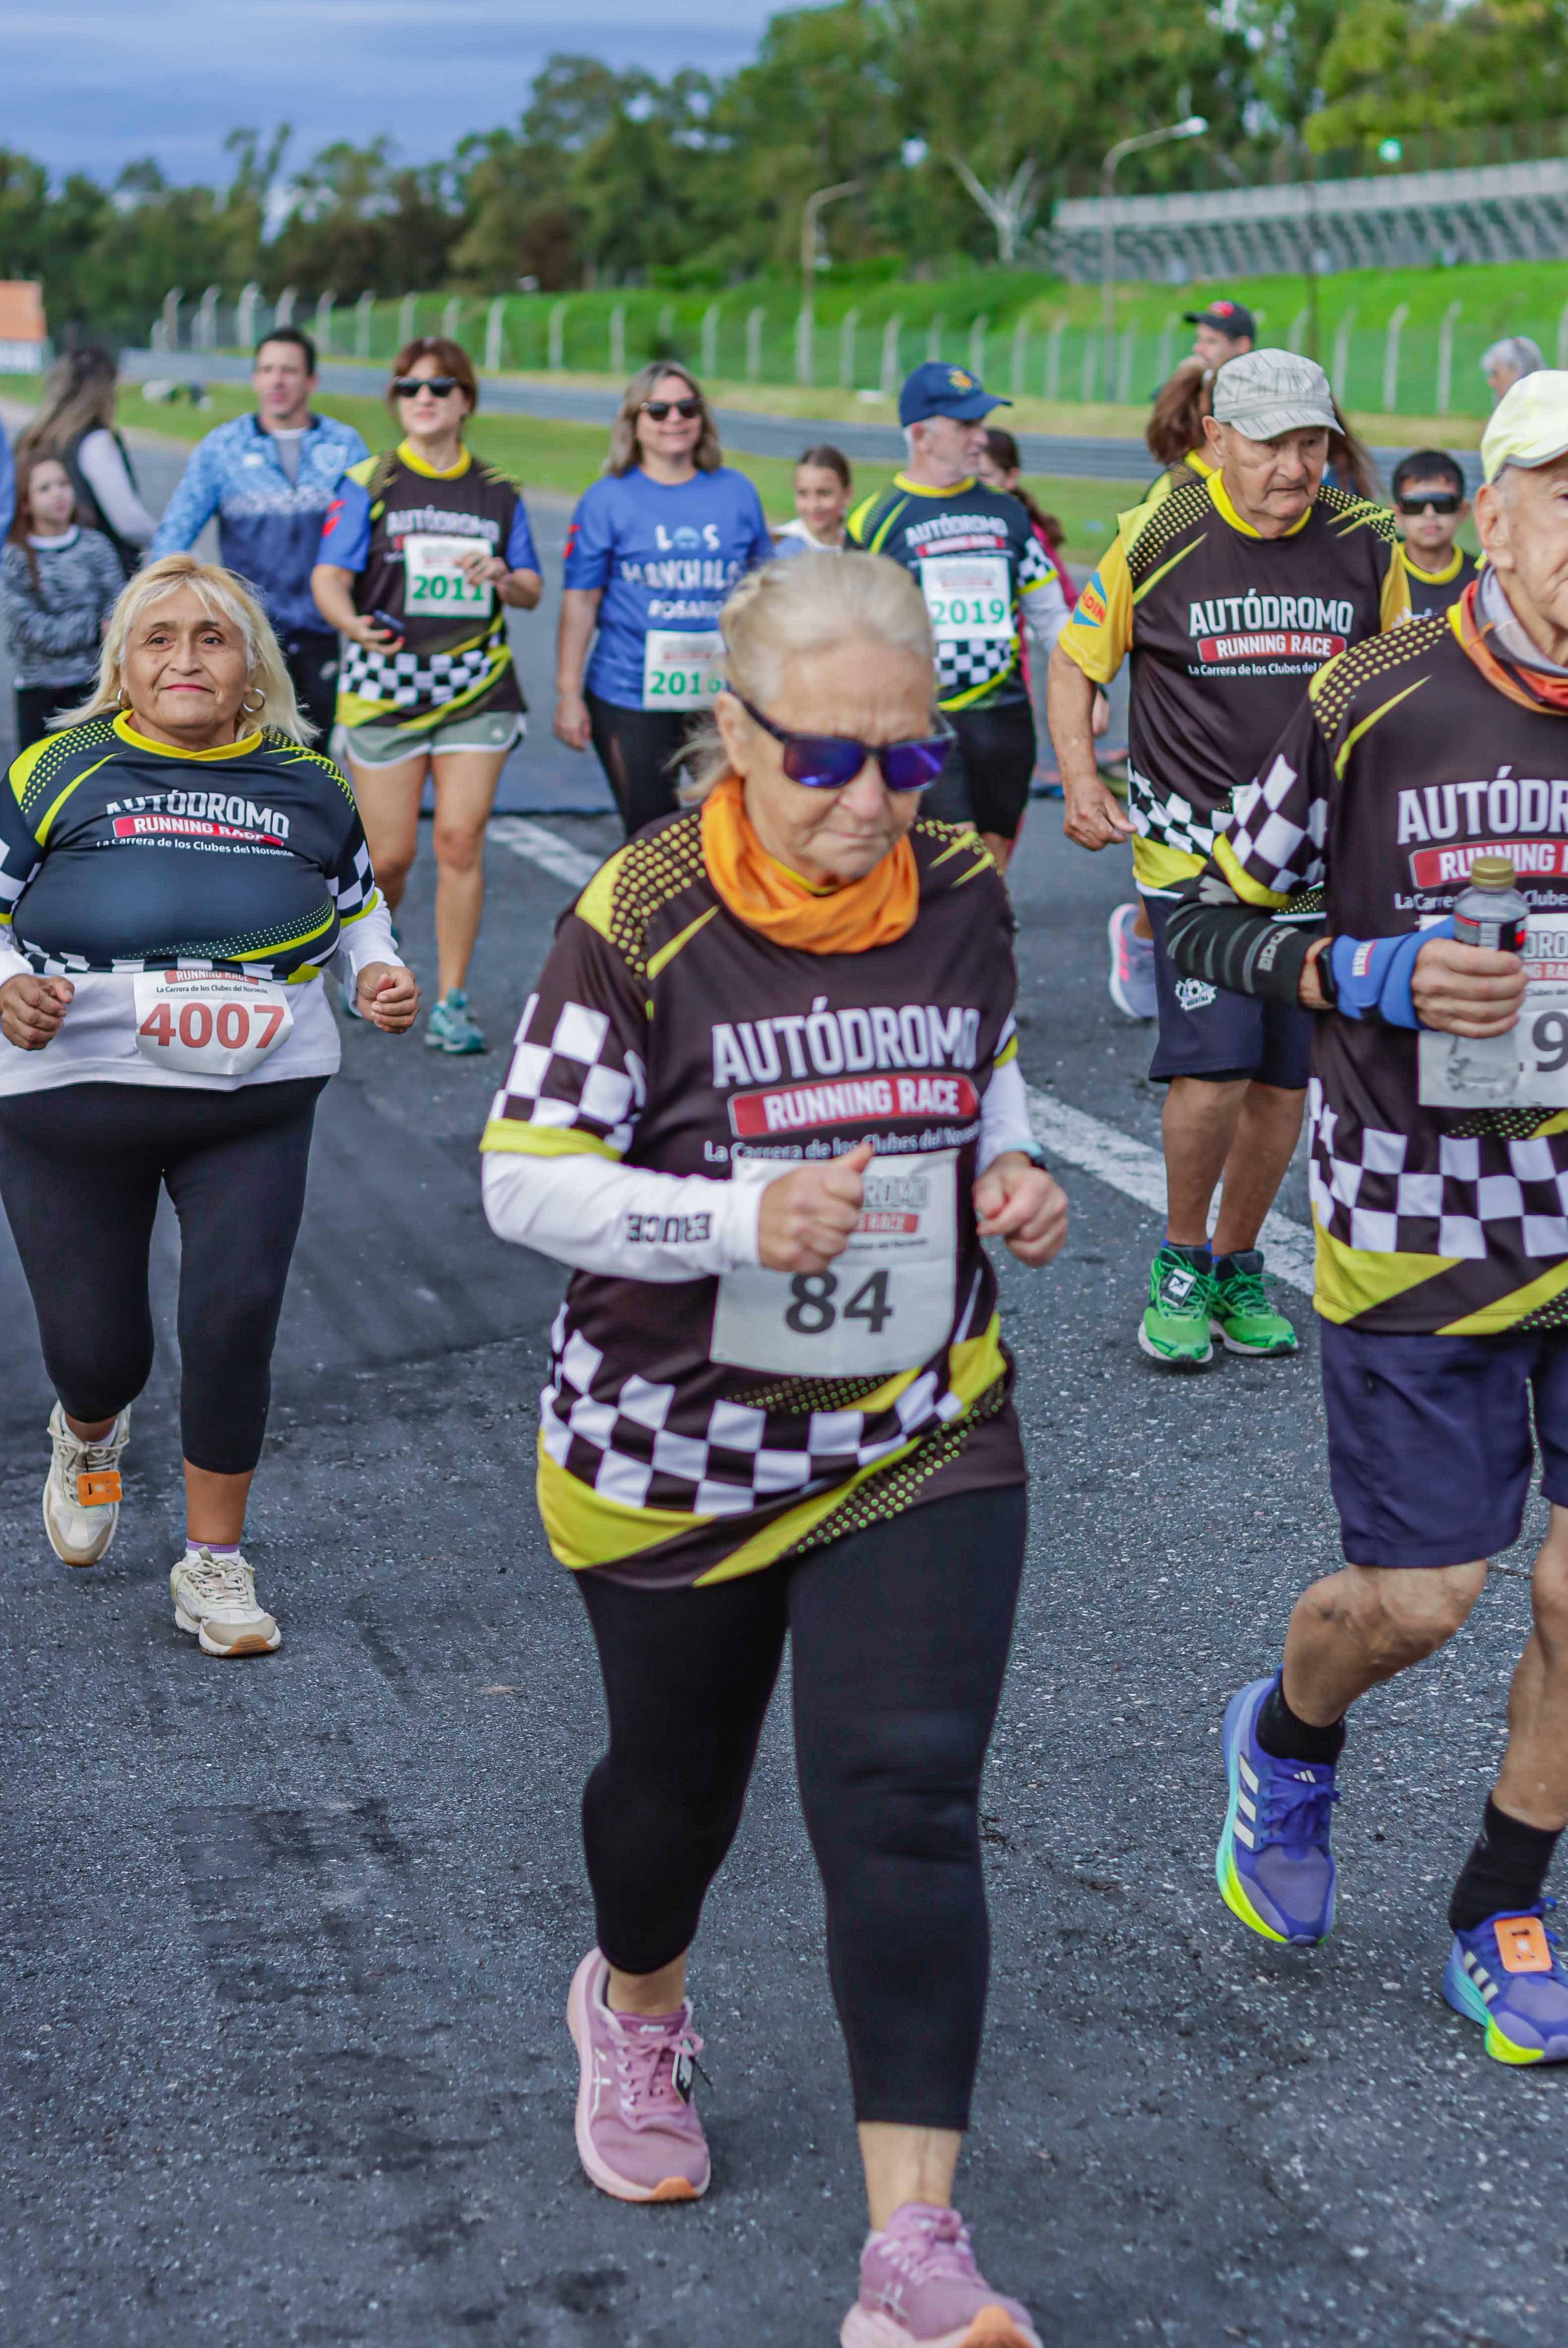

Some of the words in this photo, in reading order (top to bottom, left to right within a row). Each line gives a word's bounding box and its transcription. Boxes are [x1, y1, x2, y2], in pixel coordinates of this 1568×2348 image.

[930, 599, 1005, 625] 2019
[1189, 588, 1354, 637] AUTÓDROMO
[1216, 634, 1286, 658] RUNNING
[1290, 635, 1333, 657] RACE
[1188, 665, 1200, 675] La
[1201, 664, 1237, 676] Carrera
[1238, 664, 1251, 675] de
[1252, 663, 1267, 674] los
[1268, 662, 1301, 674] Clubes
[1302, 662, 1317, 672] del
[106, 789, 290, 839] AUTÓDROMO
[1397, 765, 1568, 845] AUTÓDR
[133, 817, 214, 834] RUNNING
[112, 838, 155, 846] Carrera
[157, 838, 172, 848] de
[175, 839, 191, 849] los
[193, 841, 231, 853] Clubes
[233, 845, 250, 854] del
[251, 846, 294, 857] Noroeste
[1395, 893, 1413, 909] La
[1413, 894, 1456, 910] Carre
[1523, 890, 1568, 906] Clube
[176, 970, 223, 982] RUNNING
[139, 1002, 284, 1049] 4007
[712, 996, 980, 1088] AUTÓDROMO
[763, 1078, 894, 1131] RUNNING
[896, 1078, 960, 1115] RACE
[704, 1140, 728, 1162] La
[730, 1142, 803, 1160] Carrera
[805, 1138, 831, 1159] de
[919, 1127, 943, 1150] del
[785, 1270, 893, 1334] 84
